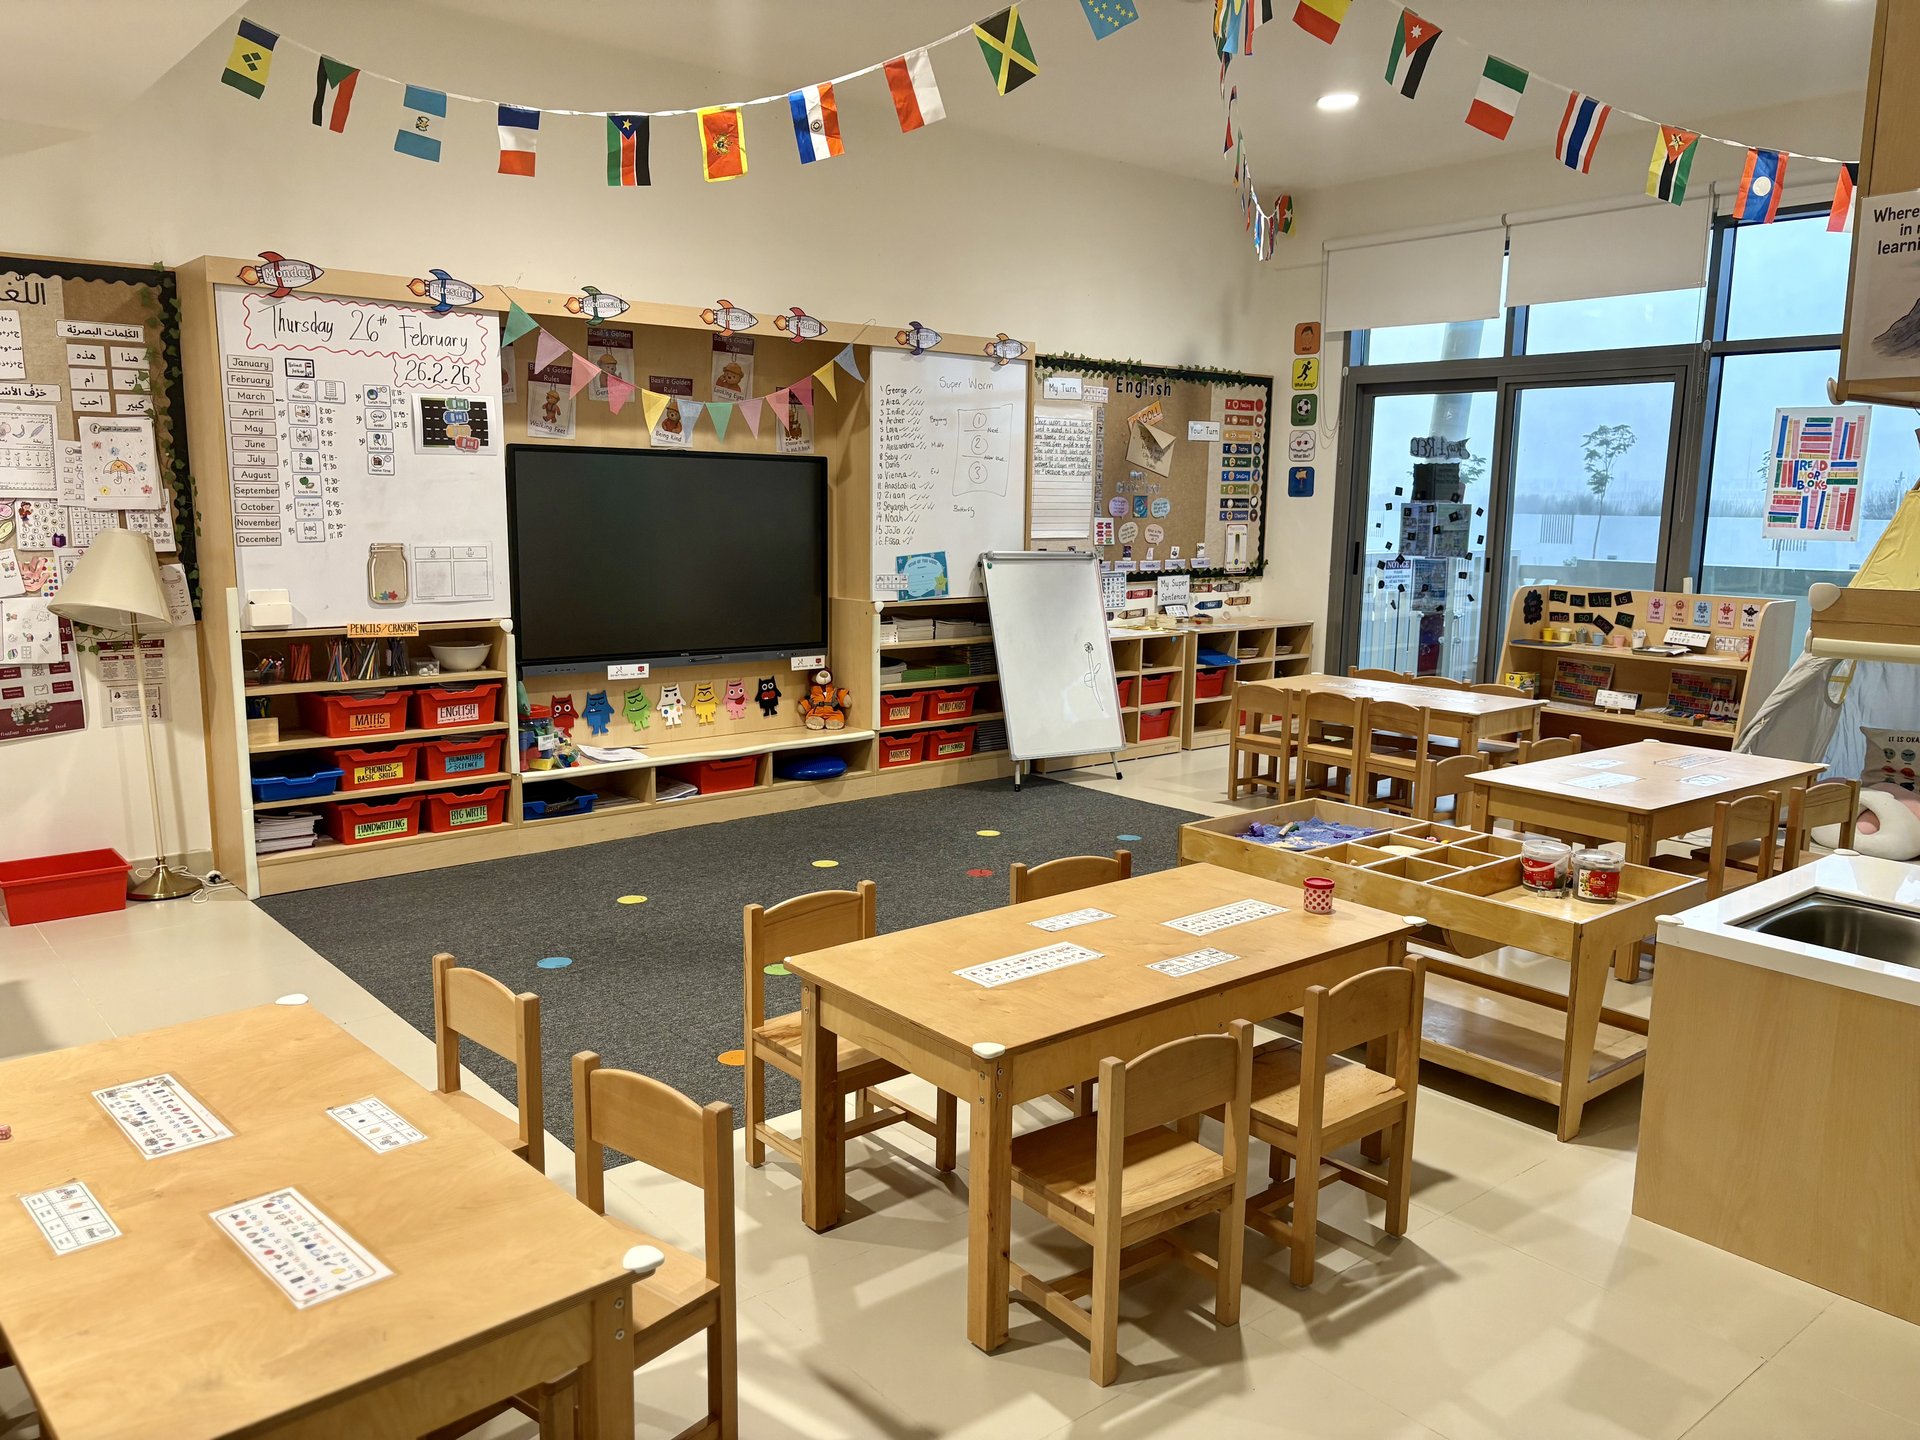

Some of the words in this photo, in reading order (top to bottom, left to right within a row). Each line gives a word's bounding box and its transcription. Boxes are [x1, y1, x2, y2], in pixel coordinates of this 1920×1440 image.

[1873, 206, 1920, 223] Where
[1900, 223, 1912, 236] in
[1877, 237, 1920, 255] learni
[264, 267, 313, 281] Monday
[431, 284, 475, 299] Tuesday
[258, 302, 334, 342] Thursday
[350, 310, 387, 342] 26th
[399, 315, 468, 357] February
[793, 320, 819, 333] Friday
[610, 330, 631, 338] Golden
[602, 339, 618, 347] Rules
[76, 350, 97, 360] هذه
[120, 352, 139, 362] هذا
[232, 357, 269, 370] January
[405, 360, 470, 385] 26.2.26
[84, 372, 94, 387] أم
[230, 374, 271, 387] February
[543, 375, 560, 383] Rules
[651, 376, 670, 385] Basil's
[671, 378, 691, 386] Golden
[939, 376, 962, 392] Super
[968, 378, 994, 390] Worm
[885, 384, 908, 397] George
[1048, 383, 1059, 396] My
[1061, 382, 1077, 393] Turn
[1116, 376, 1171, 399] English
[237, 391, 266, 401] March
[713, 386, 733, 398] Looking
[733, 393, 745, 401] Eyes
[126, 399, 145, 412] كبير
[241, 408, 264, 418] April
[886, 416, 905, 424] Archer
[244, 424, 264, 435] May
[530, 419, 553, 432] Walking
[554, 427, 566, 435] Feet
[1190, 425, 1203, 435] Your
[1205, 425, 1218, 436] Turn
[655, 430, 669, 441] Being
[670, 433, 682, 442] Kind
[244, 440, 266, 449] June
[247, 454, 266, 465] July
[323, 462, 337, 470] 9:30
[930, 467, 940, 475] End
[1799, 460, 1828, 471] READ
[241, 470, 272, 481] August
[884, 471, 908, 480] Vienna
[1799, 470, 1827, 483] MORE
[235, 486, 279, 496] September
[1797, 480, 1828, 494] BOOKS
[240, 502, 275, 511] October
[236, 518, 279, 527] November
[884, 513, 904, 522] Noah
[238, 534, 279, 543] December
[1160, 581, 1170, 591] My
[1172, 580, 1188, 588] Super
[1161, 593, 1187, 601] Sentence
[1553, 592, 1565, 600] to
[1593, 595, 1610, 605] the
[1619, 595, 1628, 604] is
[1551, 613, 1569, 621] into
[440, 704, 476, 718] ENGLISH
[355, 713, 386, 726] MATHS
[448, 752, 483, 763] HUMANITIES
[357, 773, 375, 783] BASIC
[378, 771, 397, 780] SKILLS
[451, 809, 464, 821] BIG
[465, 805, 487, 818] WRITE
[357, 819, 405, 833] HANDWRITING
